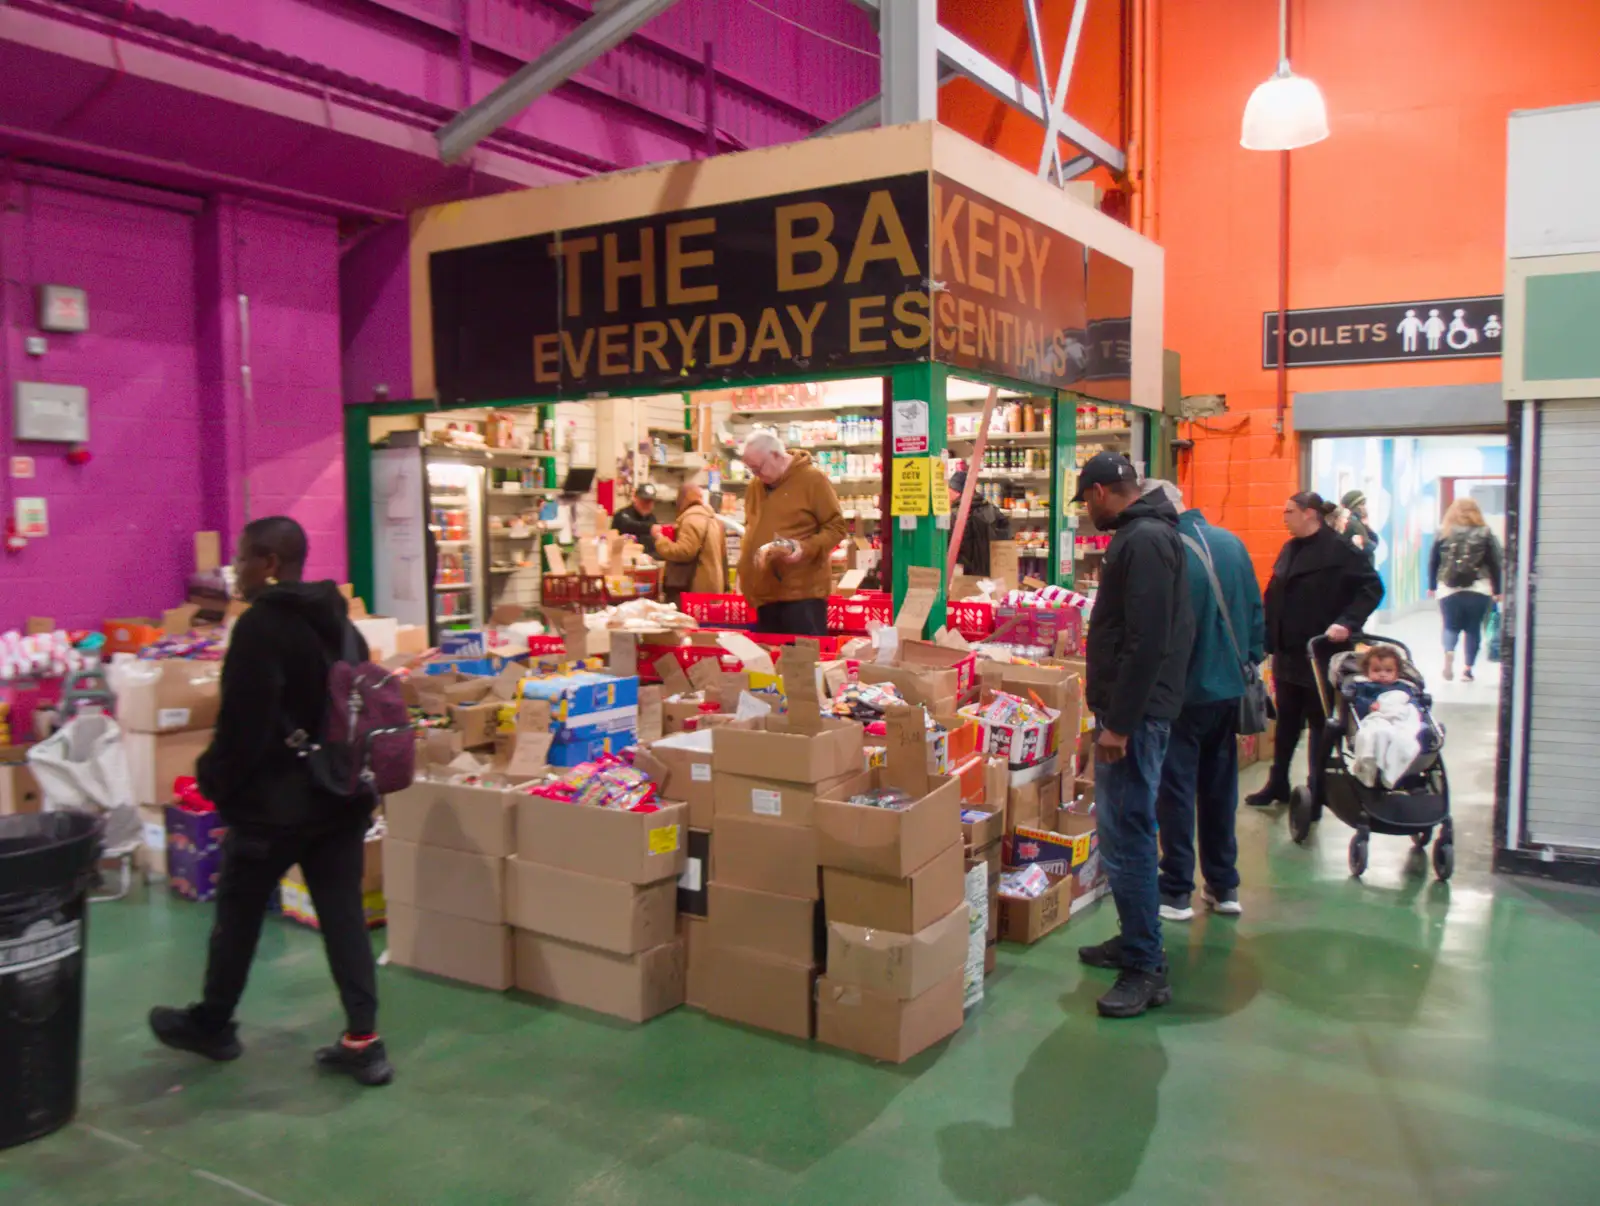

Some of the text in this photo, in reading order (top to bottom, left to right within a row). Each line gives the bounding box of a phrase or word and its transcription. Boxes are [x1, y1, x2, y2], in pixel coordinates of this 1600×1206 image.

[548, 217, 719, 317] THE
[533, 301, 828, 383] EVERYDAY
[1272, 322, 1388, 347] OILETS
